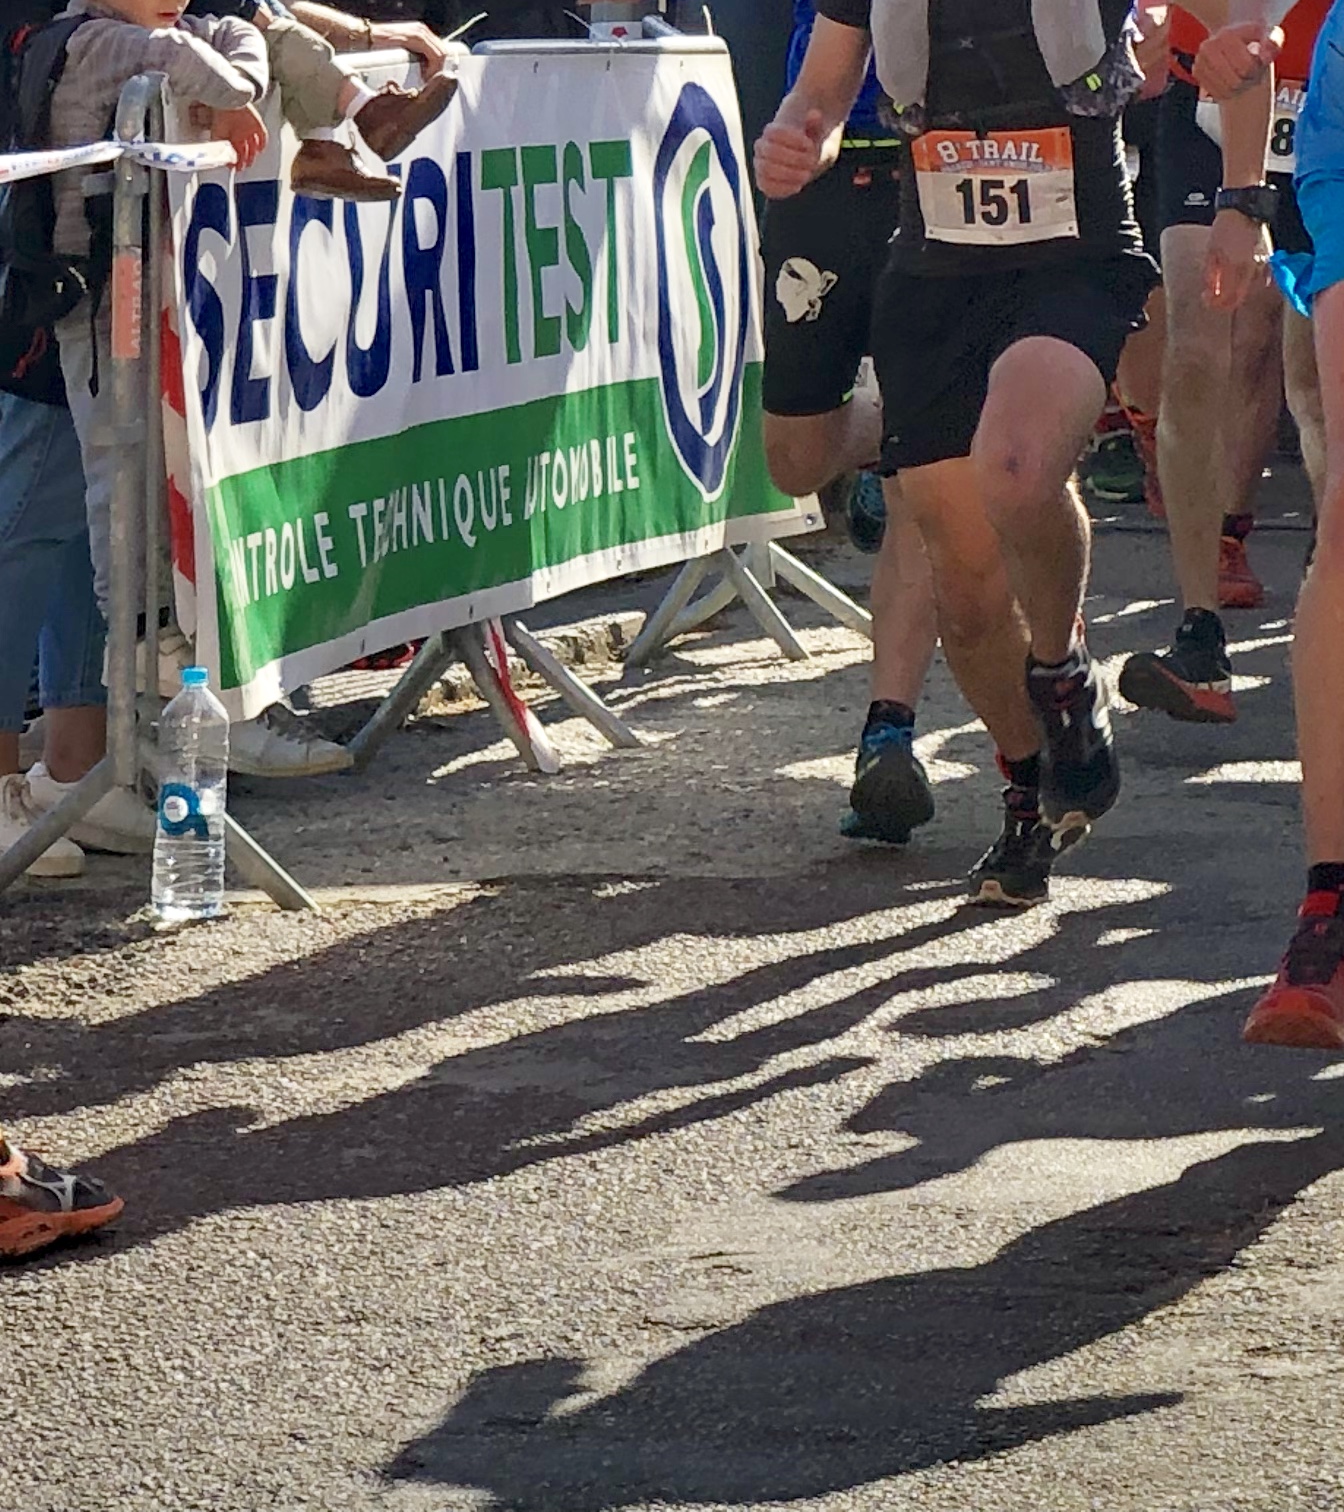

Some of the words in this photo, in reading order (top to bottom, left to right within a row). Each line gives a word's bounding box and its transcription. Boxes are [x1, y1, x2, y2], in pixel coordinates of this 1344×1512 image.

[966, 140, 1043, 163] TRAIL
[955, 178, 1032, 226] 151
[183, 139, 633, 436] SECURITEST
[348, 464, 513, 568] TEHNIQUE
